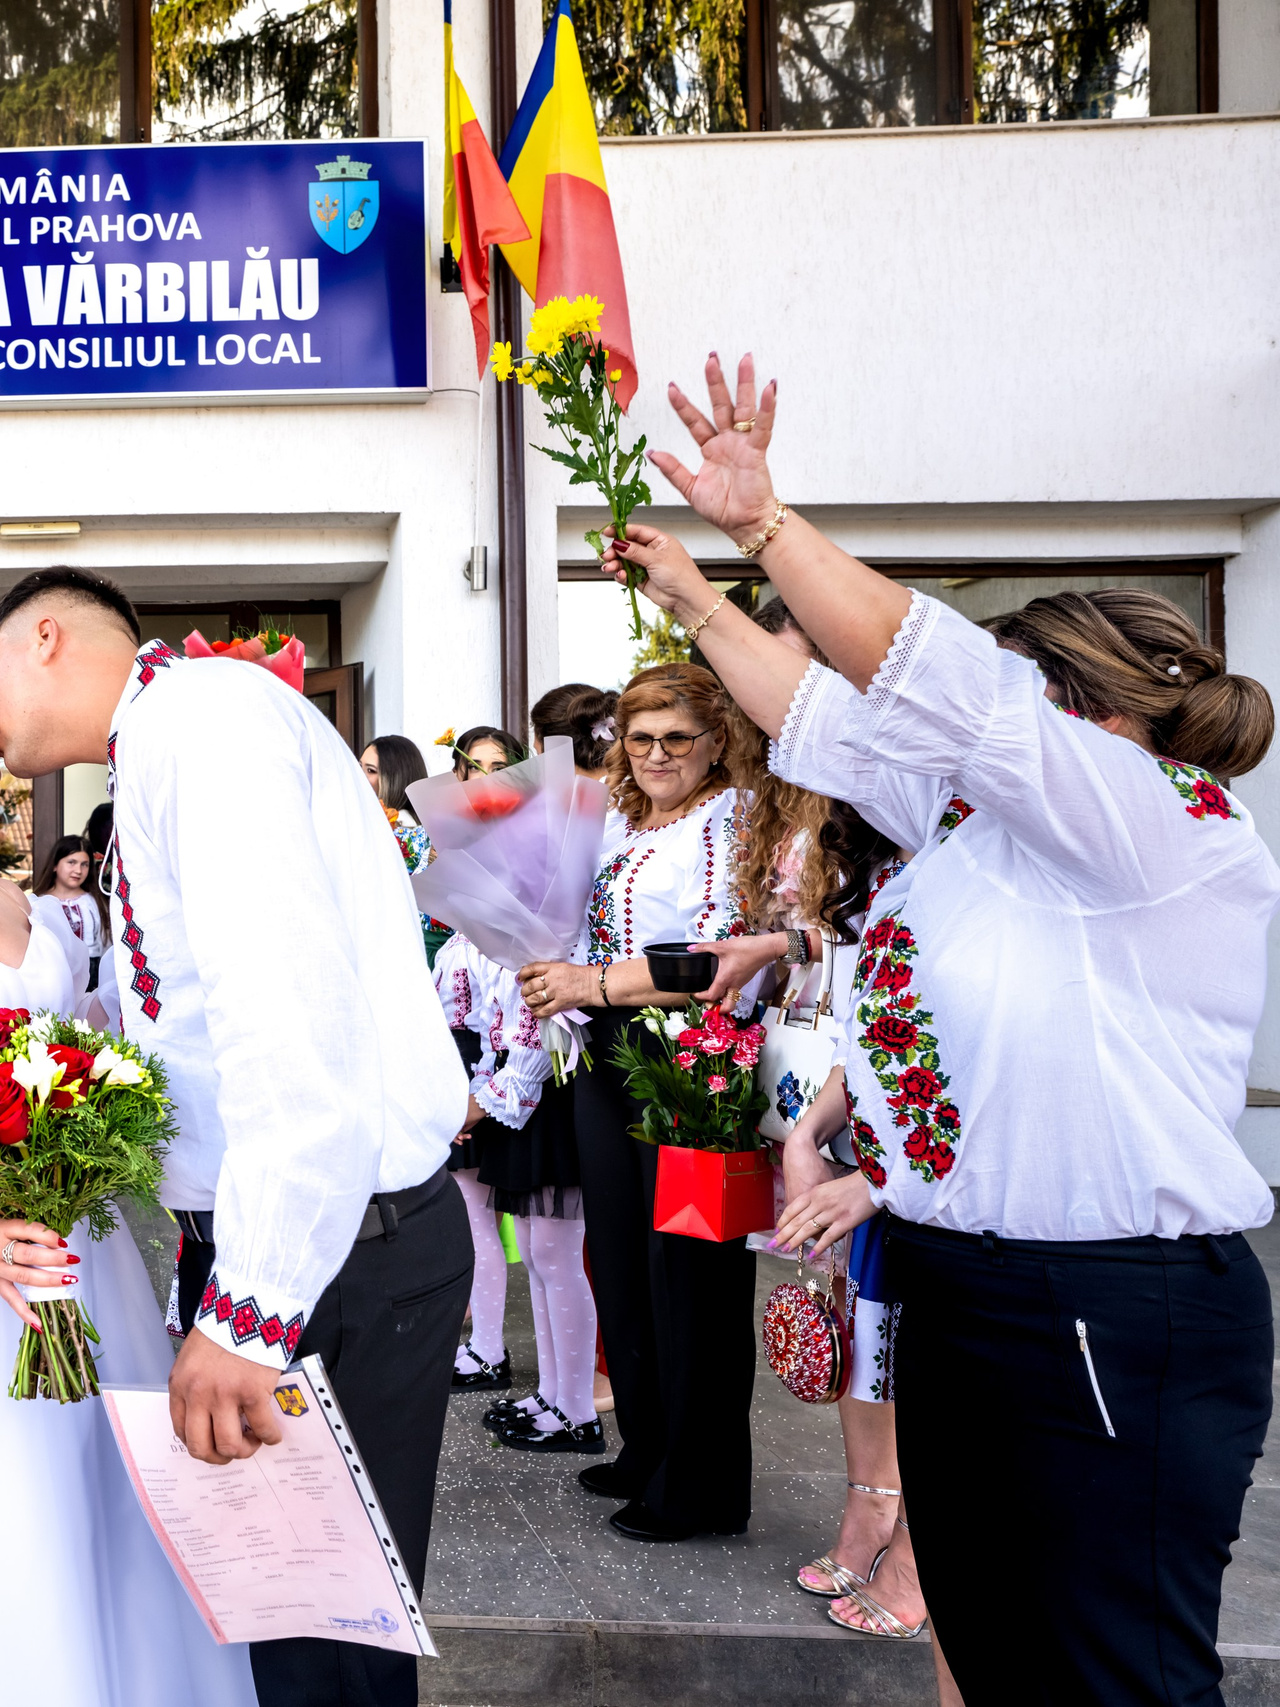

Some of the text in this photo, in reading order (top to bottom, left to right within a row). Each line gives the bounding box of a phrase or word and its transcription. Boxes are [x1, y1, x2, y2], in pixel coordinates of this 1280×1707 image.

[30, 211, 203, 245] PRAHOVA
[22, 245, 320, 326] VĂRBILĂU
[197, 332, 322, 366] LOCAL
